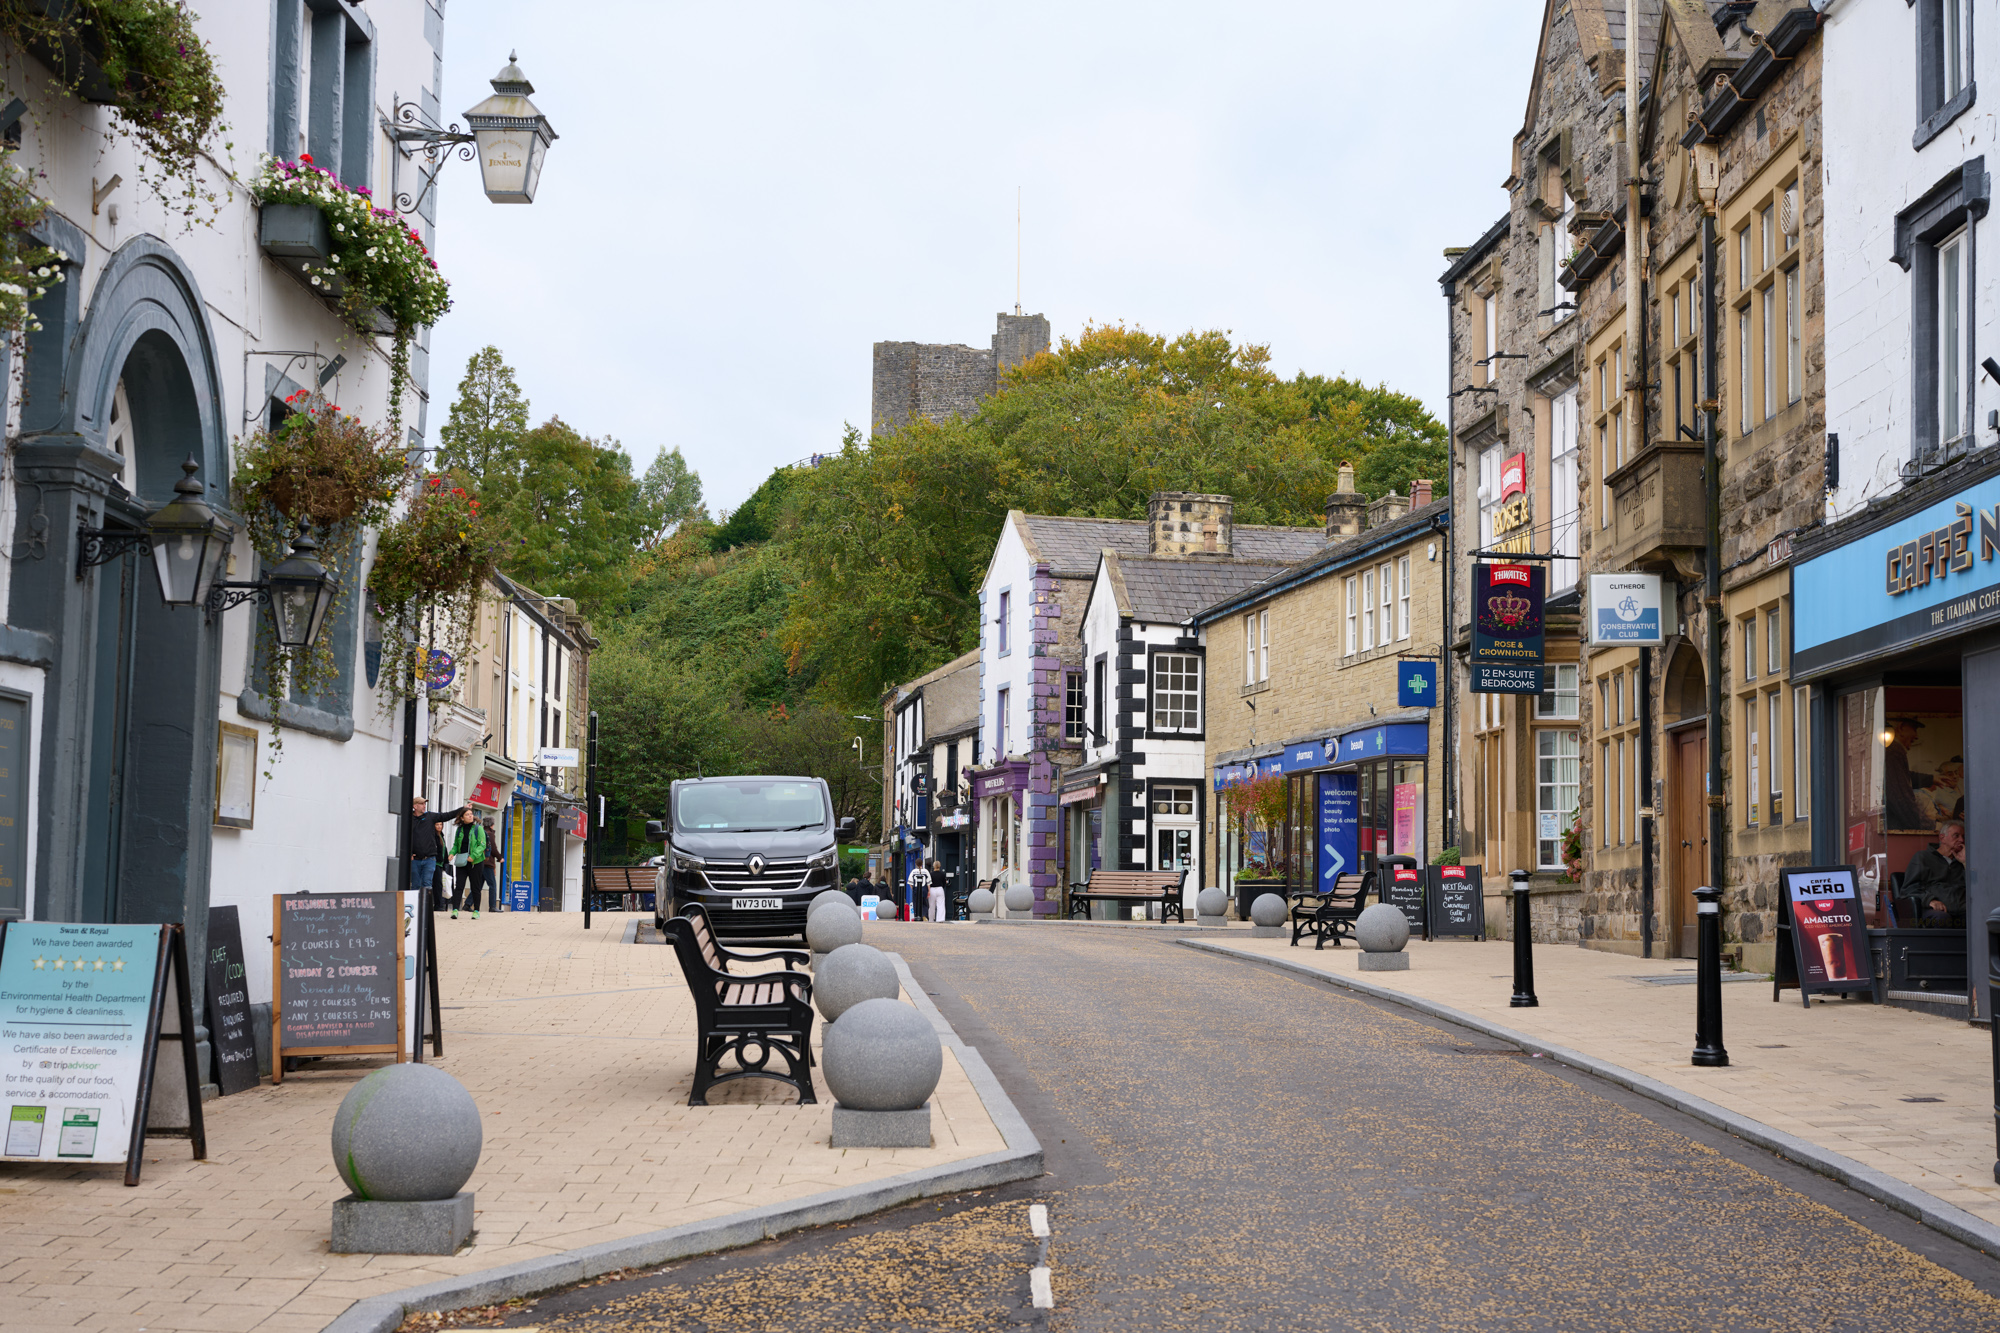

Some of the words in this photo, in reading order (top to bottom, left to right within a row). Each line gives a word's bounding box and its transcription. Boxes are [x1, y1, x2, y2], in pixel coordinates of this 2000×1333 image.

[488, 159, 521, 167] JENNINGS
[1493, 500, 1519, 538] ROSE
[1521, 496, 1528, 522] &
[1633, 508, 1645, 531] CLUB
[1886, 502, 1973, 596] CAFFÈ
[1494, 570, 1527, 581] THWAITES
[1931, 609, 1945, 626] THE
[1947, 598, 1976, 620] ITALIAN
[1492, 670, 1535, 679] EN-SUITE
[1482, 679, 1535, 689] BEDROOMS
[1350, 739, 1364, 750] beauty
[1296, 751, 1313, 762] pharmacy
[1442, 883, 1457, 891] NEXT
[1457, 882, 1473, 890] BAND
[1799, 884, 1845, 895] NERO
[285, 899, 337, 911] PENSIONER
[341, 897, 375, 909] SPECIAL
[736, 900, 759, 908] NV73
[762, 900, 778, 908] OVL
[293, 912, 325, 922] Served
[355, 912, 373, 925] day
[1803, 915, 1851, 924] AMARETTO
[338, 925, 358, 937] 3pm
[32, 938, 47, 946] We
[49, 938, 70, 947] have
[72, 939, 94, 948] been
[96, 940, 133, 948] awarded
[291, 942, 297, 950] 2
[302, 940, 340, 950] COURSES
[212, 946, 226, 963] CHEF
[289, 967, 322, 979] SUNDAY
[326, 967, 335, 978] 2
[338, 965, 378, 977] COURSER
[62, 980, 72, 989] by
[300, 982, 334, 994] Served
[337, 984, 350, 994] all
[354, 984, 375, 1001] day
[0, 991, 63, 1001] Environmental
[65, 993, 93, 1002] Health
[95, 994, 146, 1004] Department
[218, 991, 244, 1007] REQUIRED
[292, 1000, 309, 1008] ANY
[322, 998, 357, 1007] COURSES
[16, 1005, 28, 1014] for
[30, 1006, 64, 1017] hygiene
[66, 1007, 73, 1015] &
[75, 1007, 125, 1016] cleanliness.
[322, 1011, 358, 1020] COURSES
[223, 1012, 244, 1026] ENQUIRE
[287, 1024, 314, 1032] BOOKING
[2, 1030, 17, 1038] We
[19, 1030, 40, 1039] have
[42, 1030, 61, 1040] also
[63, 1031, 85, 1040] been
[87, 1032, 124, 1041] awarded
[296, 1029, 351, 1039] DISAPPOINTMENT
[13, 1045, 57, 1054] Certificate
[59, 1046, 69, 1054] of
[70, 1046, 117, 1056] Excellence
[22, 1060, 33, 1068] by
[53, 1061, 97, 1071] tripadvisor
[5, 1074, 18, 1083] for
[19, 1074, 33, 1083] the
[36, 1075, 65, 1086] quality
[66, 1076, 76, 1084] of
[94, 1076, 115, 1085] food,
[39, 1090, 46, 1098] &
[48, 1090, 111, 1100] accomodation.
